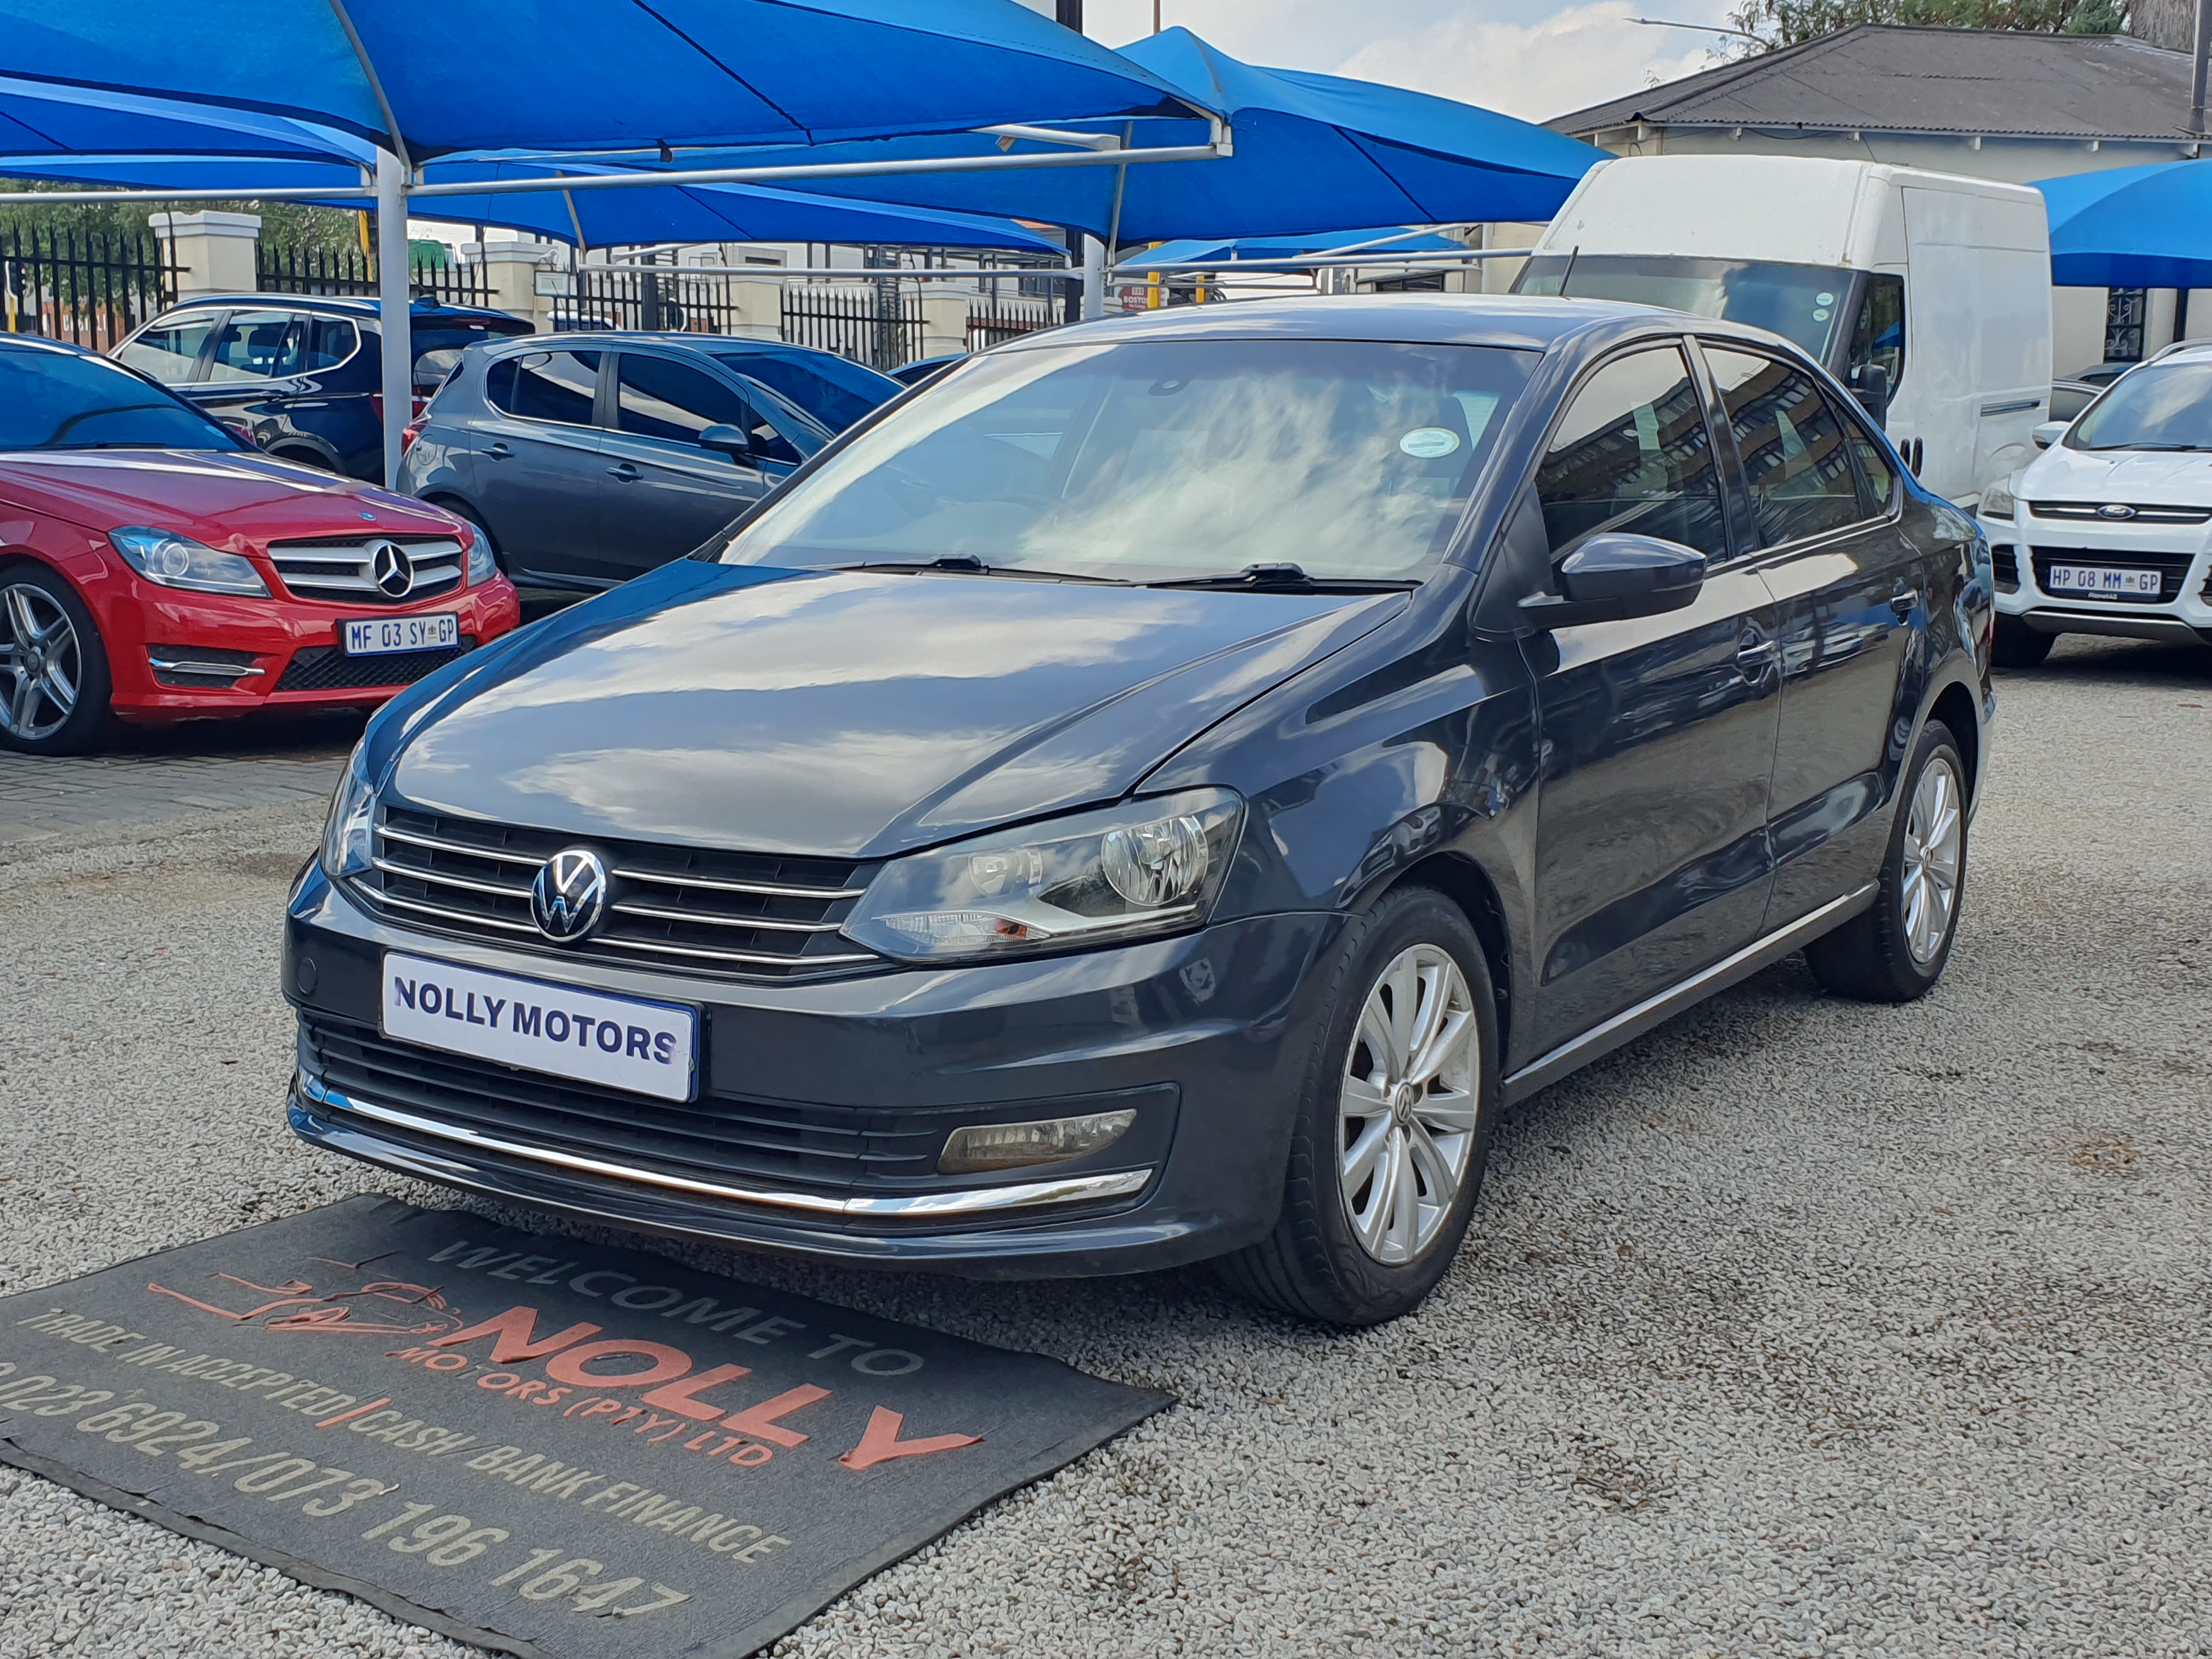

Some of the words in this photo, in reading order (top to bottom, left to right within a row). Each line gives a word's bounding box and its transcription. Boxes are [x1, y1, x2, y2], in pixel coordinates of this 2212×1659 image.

[1123, 295, 1148, 304] BOSTO
[2053, 569, 2070, 586] HP
[2078, 571, 2096, 588] 08
[2103, 571, 2121, 589] MM
[2139, 574, 2158, 591] GP
[351, 625, 373, 650] MF
[382, 623, 402, 647] 03
[409, 620, 427, 645] SY
[438, 619, 454, 642] GP
[394, 977, 507, 1028] NOLLY
[512, 1002, 678, 1065] MOTORS
[426, 1240, 808, 1345] WELCOME
[806, 1333, 926, 1376] TO
[426, 1305, 986, 1470] NOLLY
[15, 1308, 148, 1353] TRADE
[582, 1481, 793, 1564] FINANCE
[562, 1397, 686, 1444] (PTY)
[682, 1431, 775, 1467] LTD
[361, 1501, 510, 1566] 196
[489, 1548, 693, 1619] 1647
